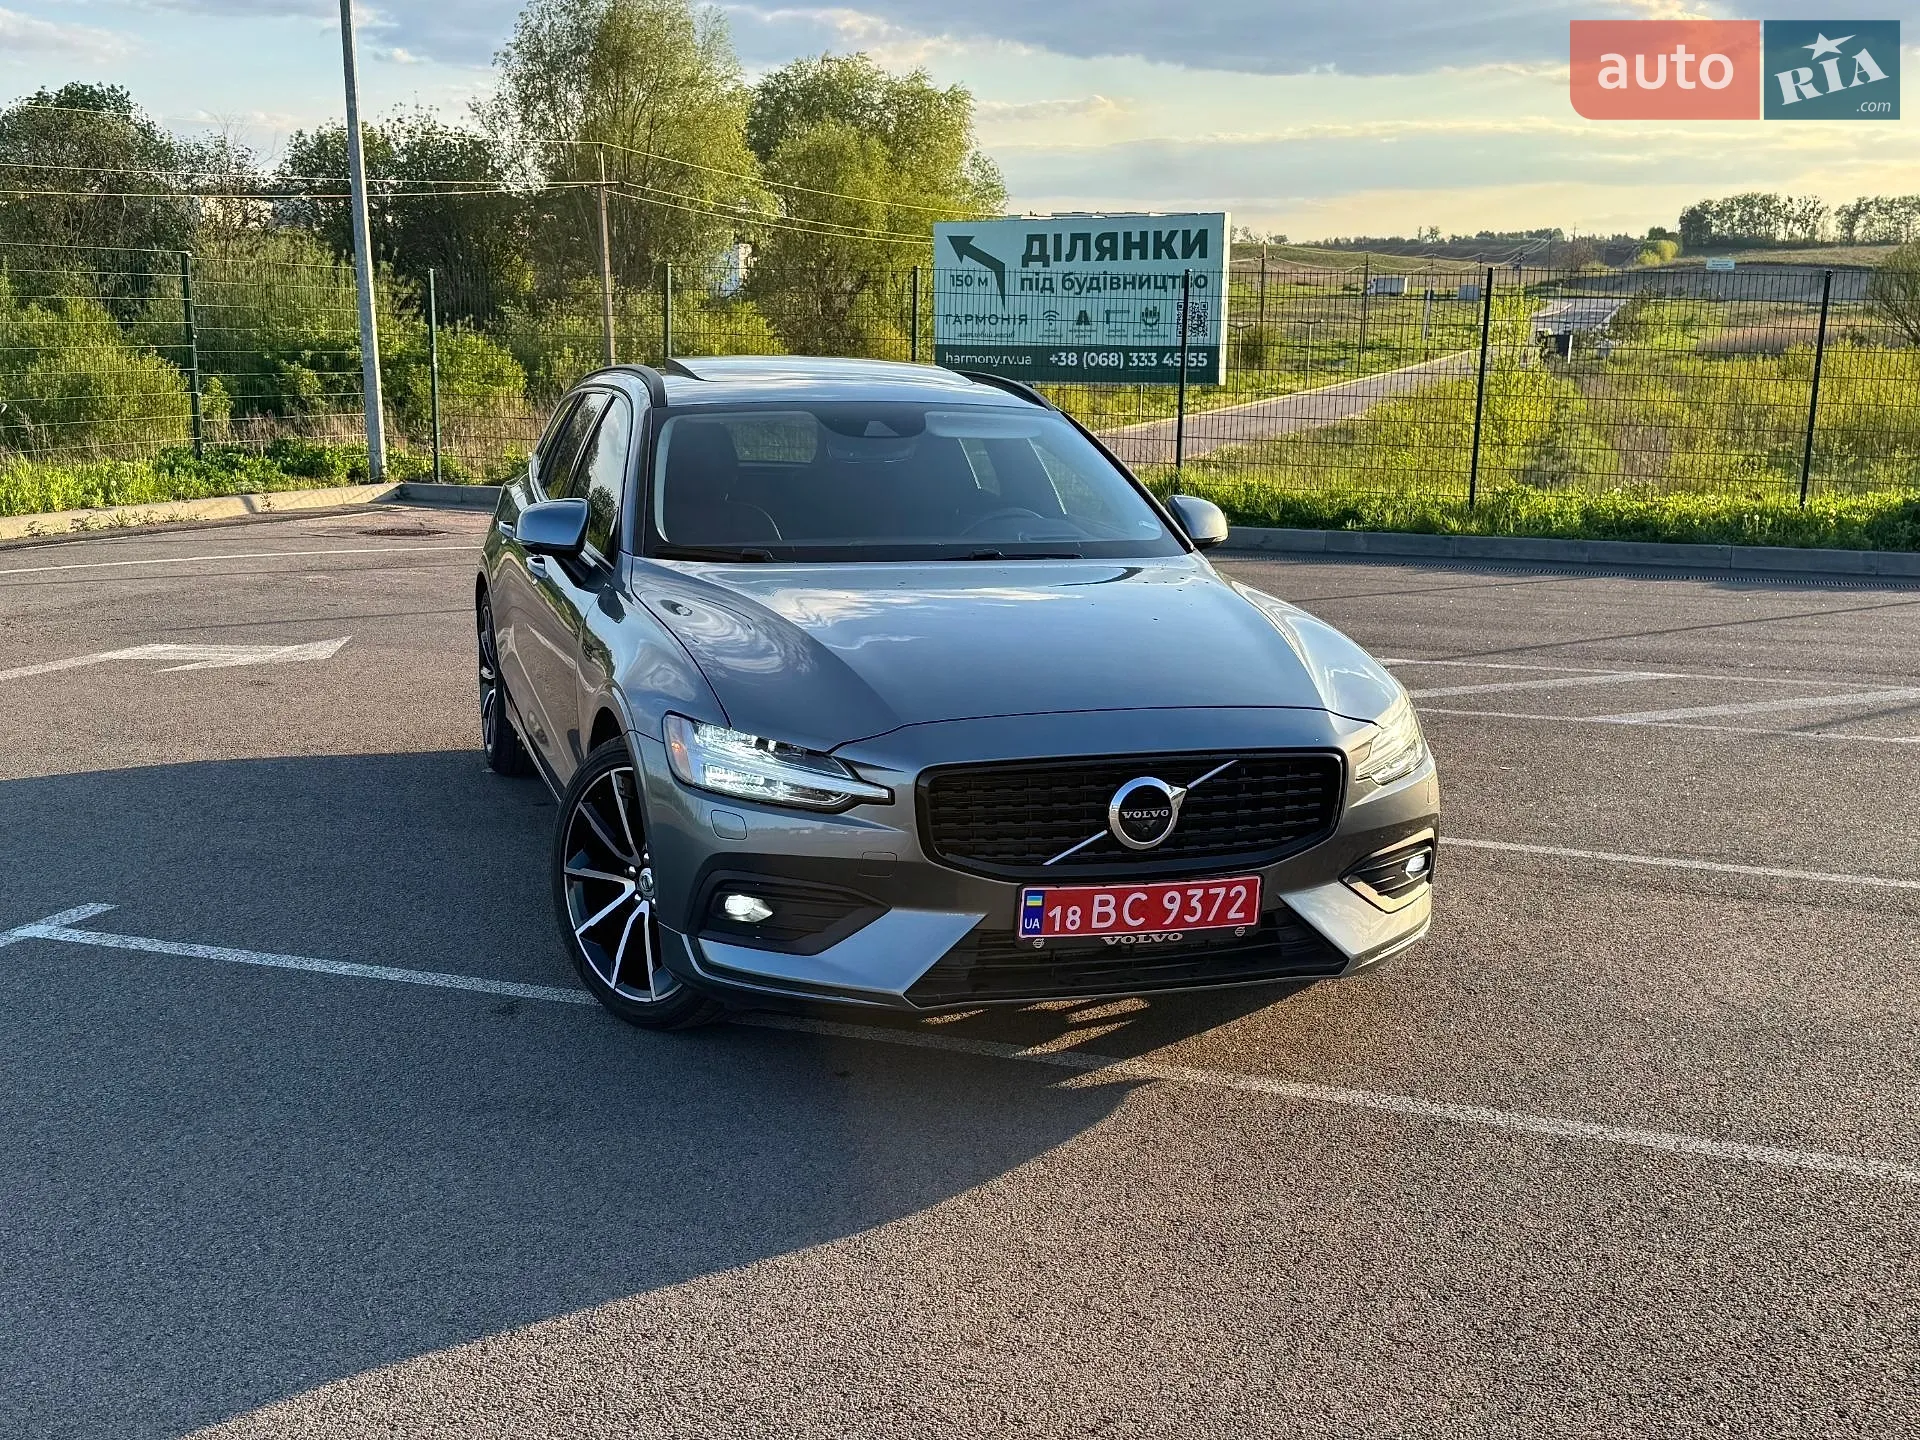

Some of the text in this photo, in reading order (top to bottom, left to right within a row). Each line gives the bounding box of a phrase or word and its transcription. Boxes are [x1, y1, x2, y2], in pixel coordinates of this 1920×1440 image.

[1021, 228, 1209, 268] ДІЛЯНКИ
[950, 274, 973, 288] 150
[1020, 273, 1055, 294] під
[945, 313, 1028, 326] ГАРМОНІЯ
[945, 352, 1032, 367] harmony.rv.ua
[1049, 352, 1208, 369] +38 (068) 333 45 55
[1121, 809, 1169, 819] VOLVO
[1047, 885, 1248, 932] 18 BC 9372
[1024, 917, 1040, 930] UA
[1101, 933, 1183, 946] VOLVO
